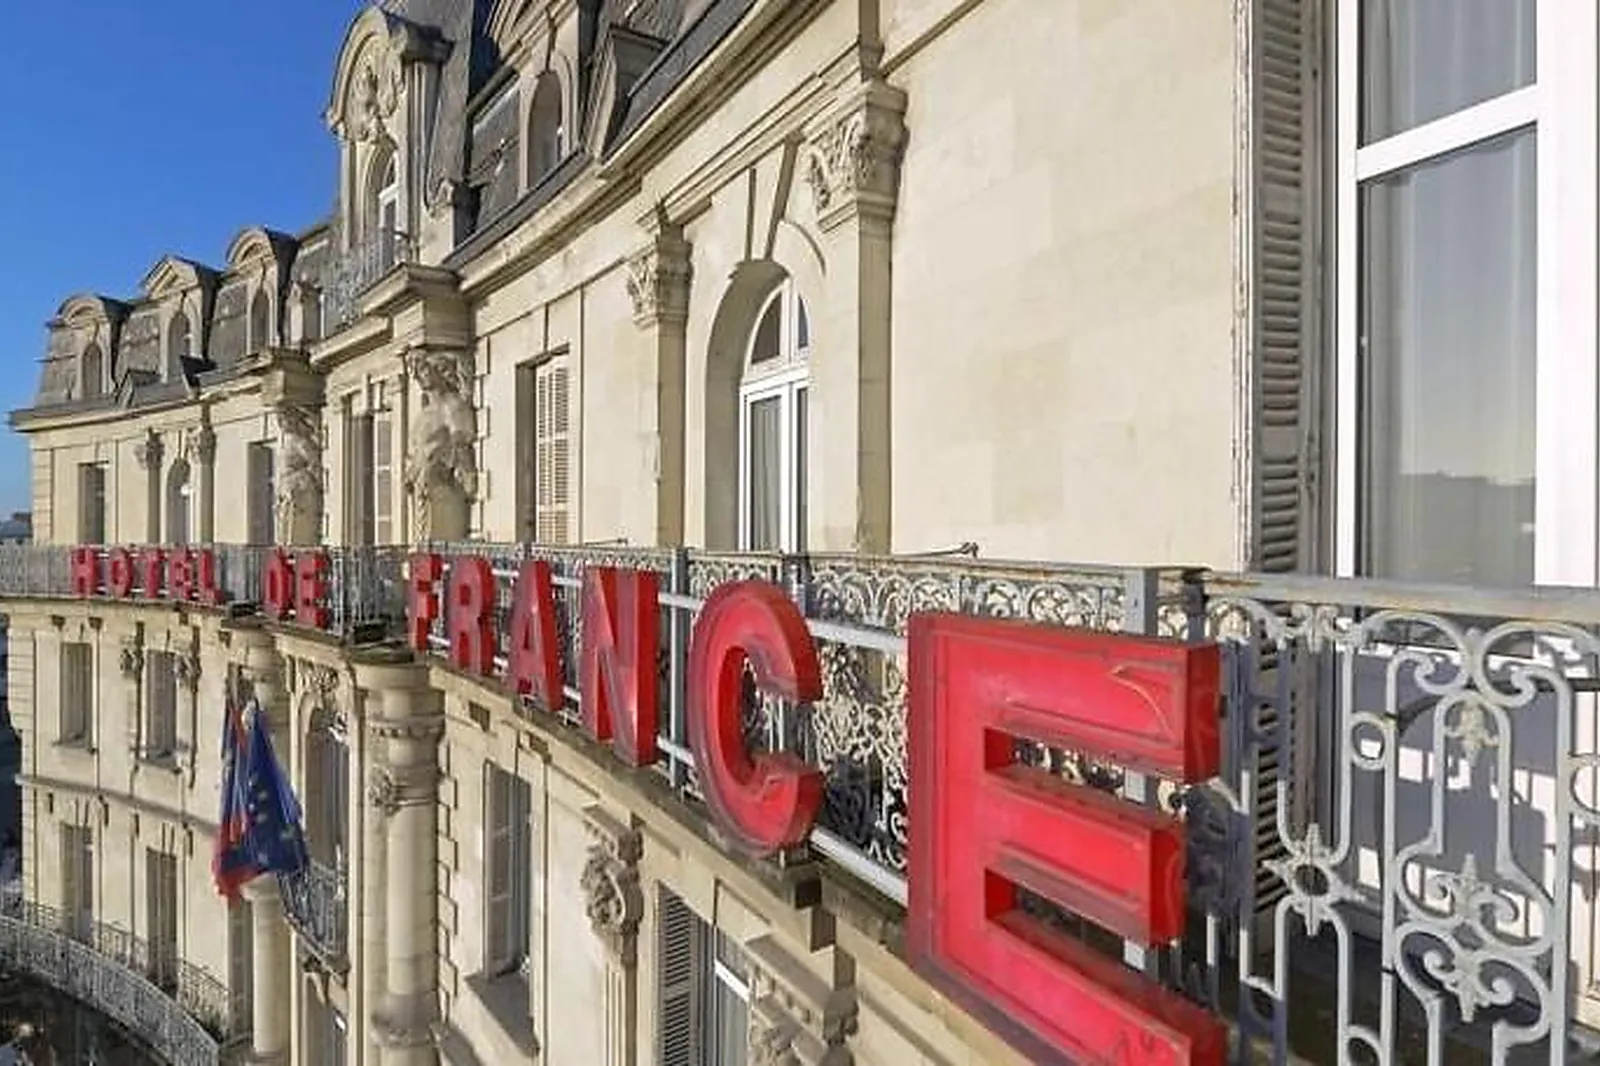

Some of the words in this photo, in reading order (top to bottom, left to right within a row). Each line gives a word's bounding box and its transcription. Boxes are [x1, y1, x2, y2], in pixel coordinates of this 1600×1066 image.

[71, 547, 224, 603] HOTEL
[264, 547, 330, 628] DE
[407, 553, 1227, 1066] FRANCE
